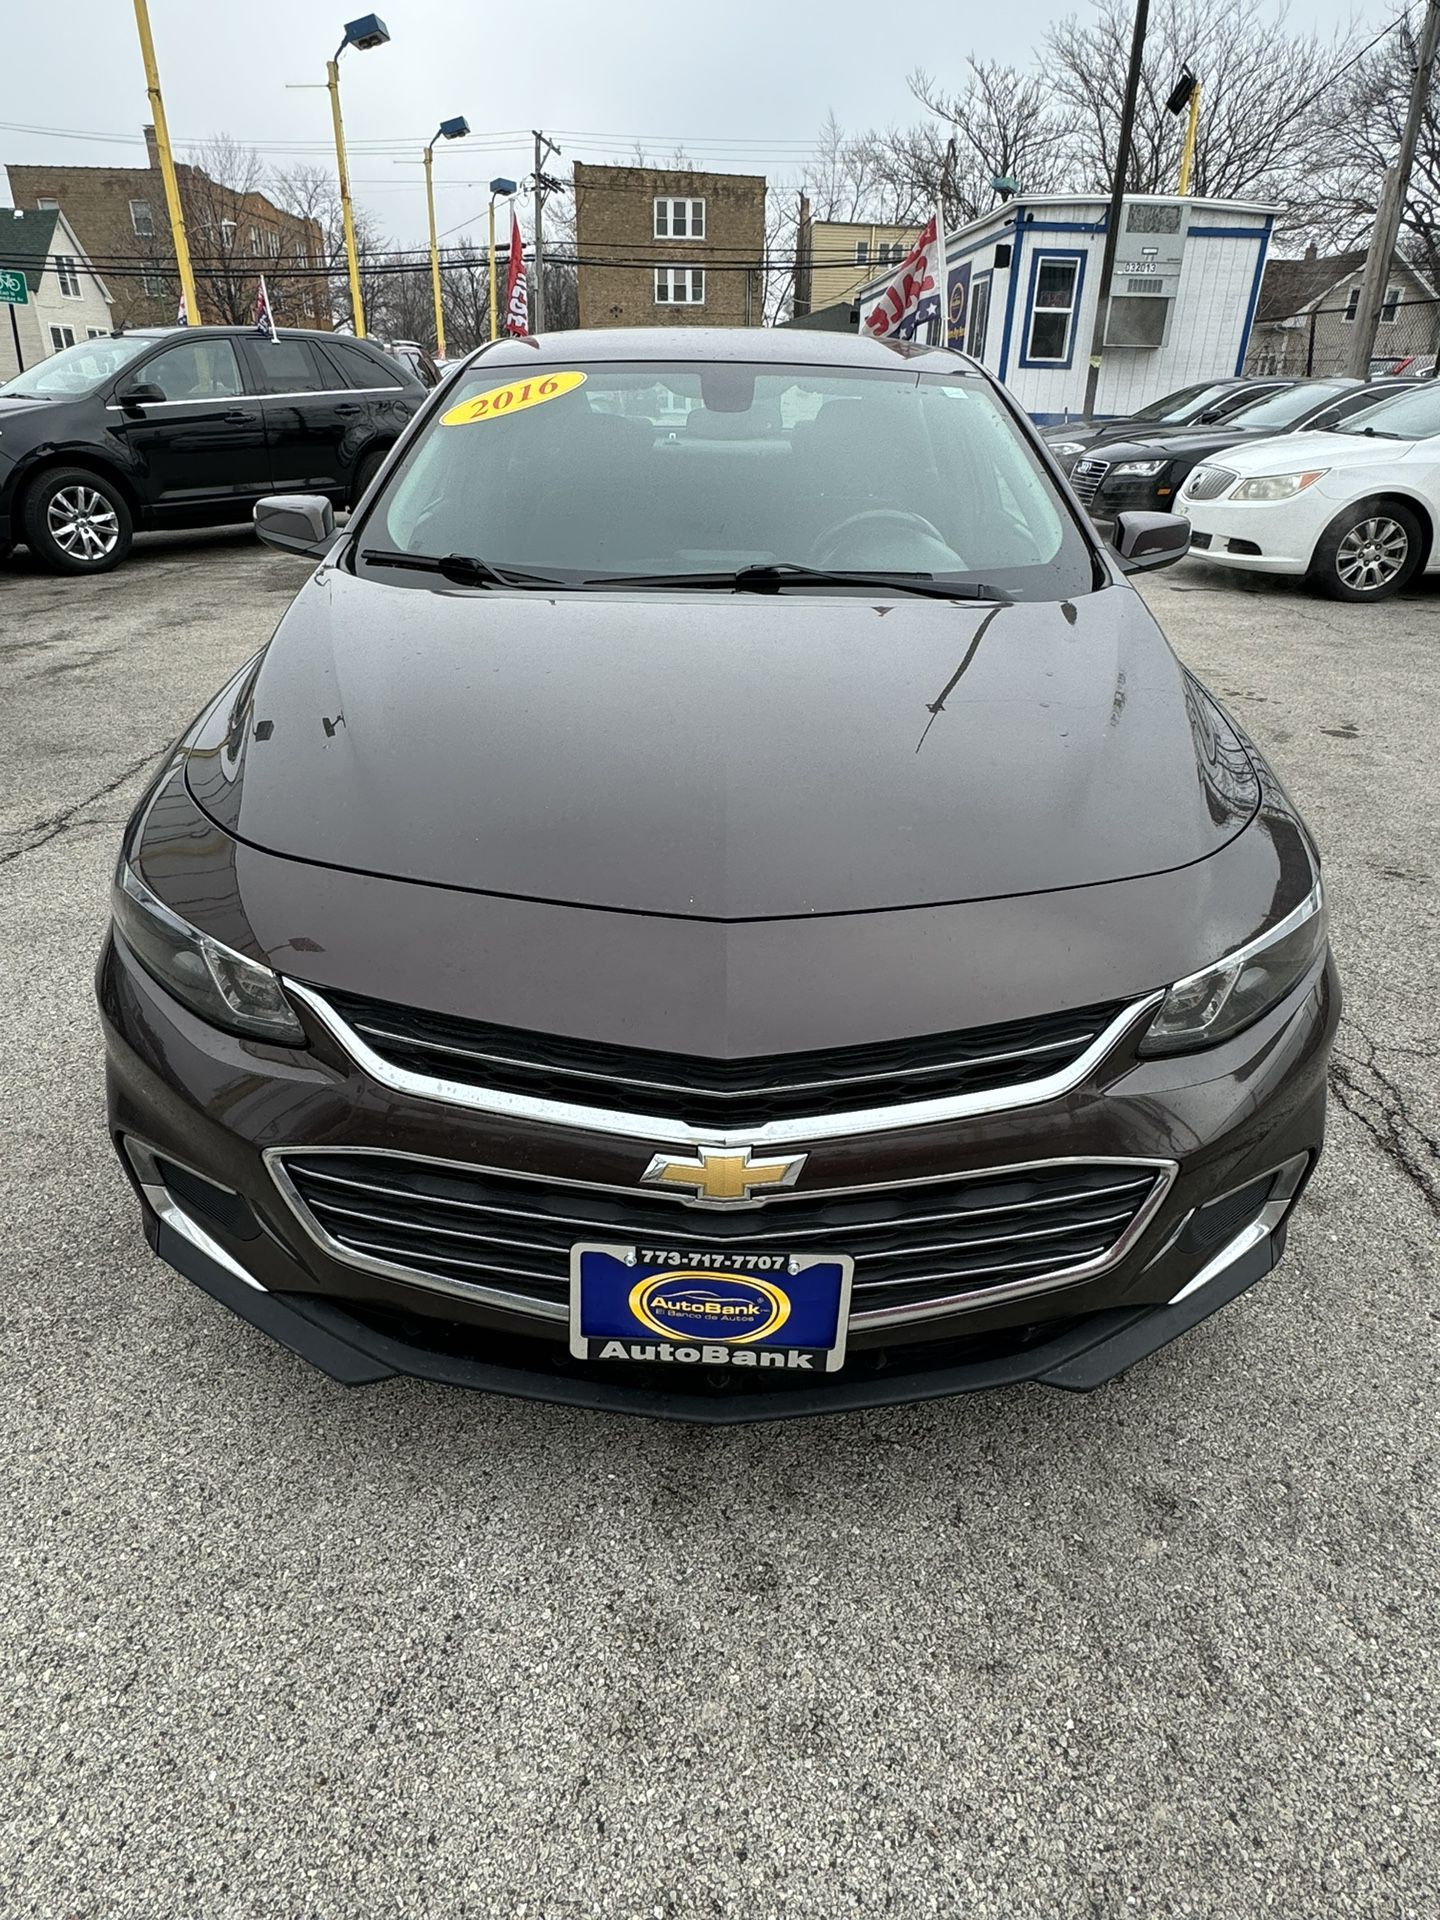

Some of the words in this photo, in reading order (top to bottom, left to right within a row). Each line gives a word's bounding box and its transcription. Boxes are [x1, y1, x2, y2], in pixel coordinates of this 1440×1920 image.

[1124, 263, 1157, 273] 032013
[470, 376, 558, 419] 2016
[641, 1250, 785, 1270] 773-717-7707
[650, 1297, 760, 1315] AutoBank
[667, 1309, 702, 1320] Banco
[598, 1341, 813, 1370] AutoBank
